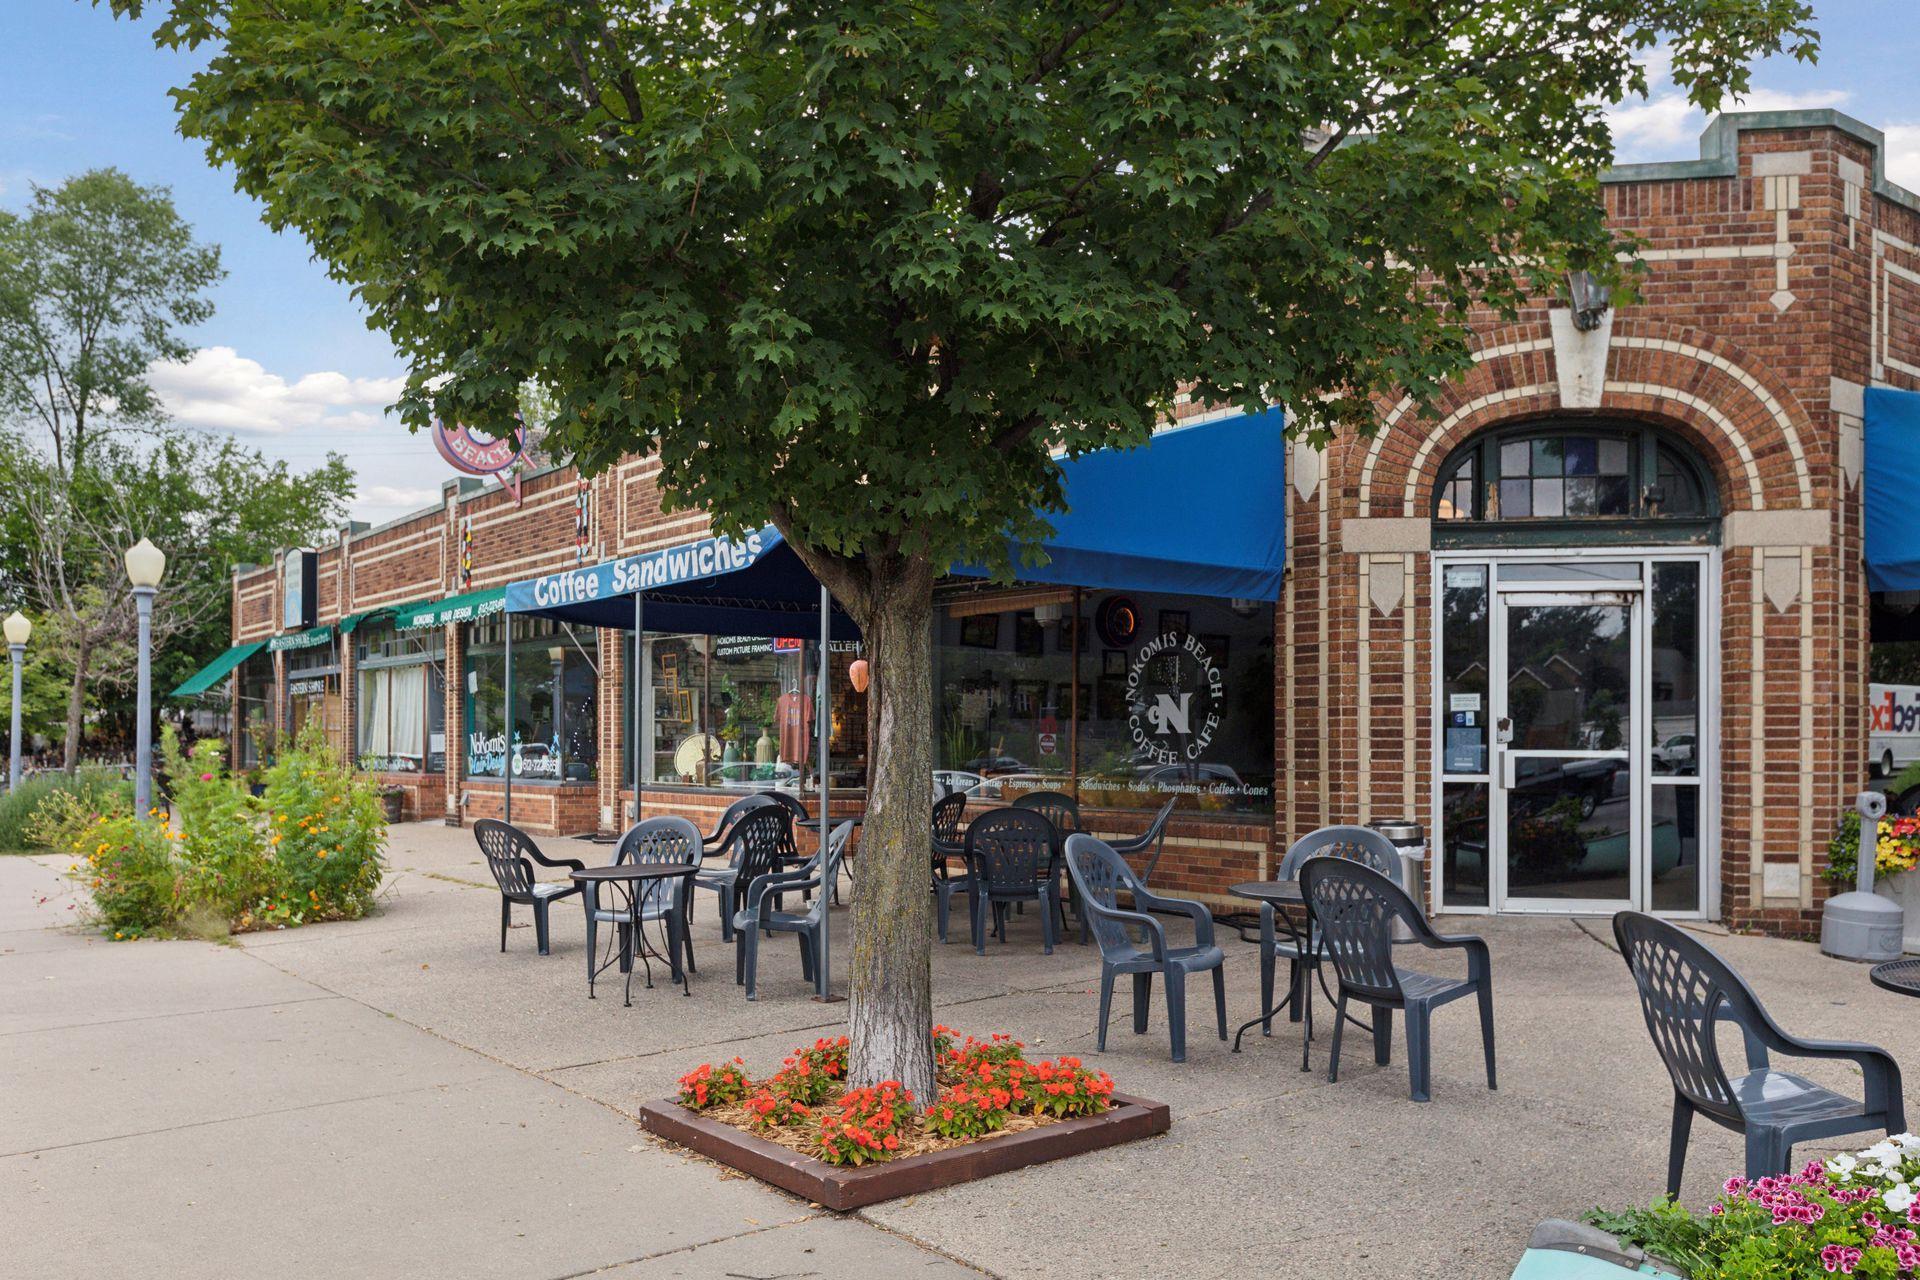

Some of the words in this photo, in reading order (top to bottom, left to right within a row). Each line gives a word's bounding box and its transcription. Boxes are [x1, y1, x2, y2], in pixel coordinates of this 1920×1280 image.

[451, 436, 515, 466] BEACH
[534, 570, 599, 607] Coffee
[611, 533, 762, 593] Sandwiches
[412, 613, 435, 626] NOKOMIS
[440, 610, 453, 622] HAIR
[452, 606, 473, 620] DESIGN
[716, 647, 733, 656] CUSTOM
[733, 645, 751, 655] PICTURE
[751, 643, 773, 653] FRAMING
[775, 636, 801, 649] OPEN
[1125, 631, 1177, 702] NOKOMIS
[1183, 634, 1223, 698] BEACH
[1128, 714, 1178, 766] COFFEE
[1186, 712, 1220, 760] CAFE
[945, 775, 954, 786] Ice
[955, 776, 974, 787] Cream
[980, 777, 1003, 788] astries
[1008, 777, 1036, 789] Espresso
[1041, 778, 1061, 790] Soups
[1079, 779, 1121, 792] Sandwiches
[1127, 780, 1150, 793] Sodas
[1157, 782, 1201, 796] Phosphates
[1208, 782, 1235, 795] Coffee
[1242, 783, 1269, 796] Cones
